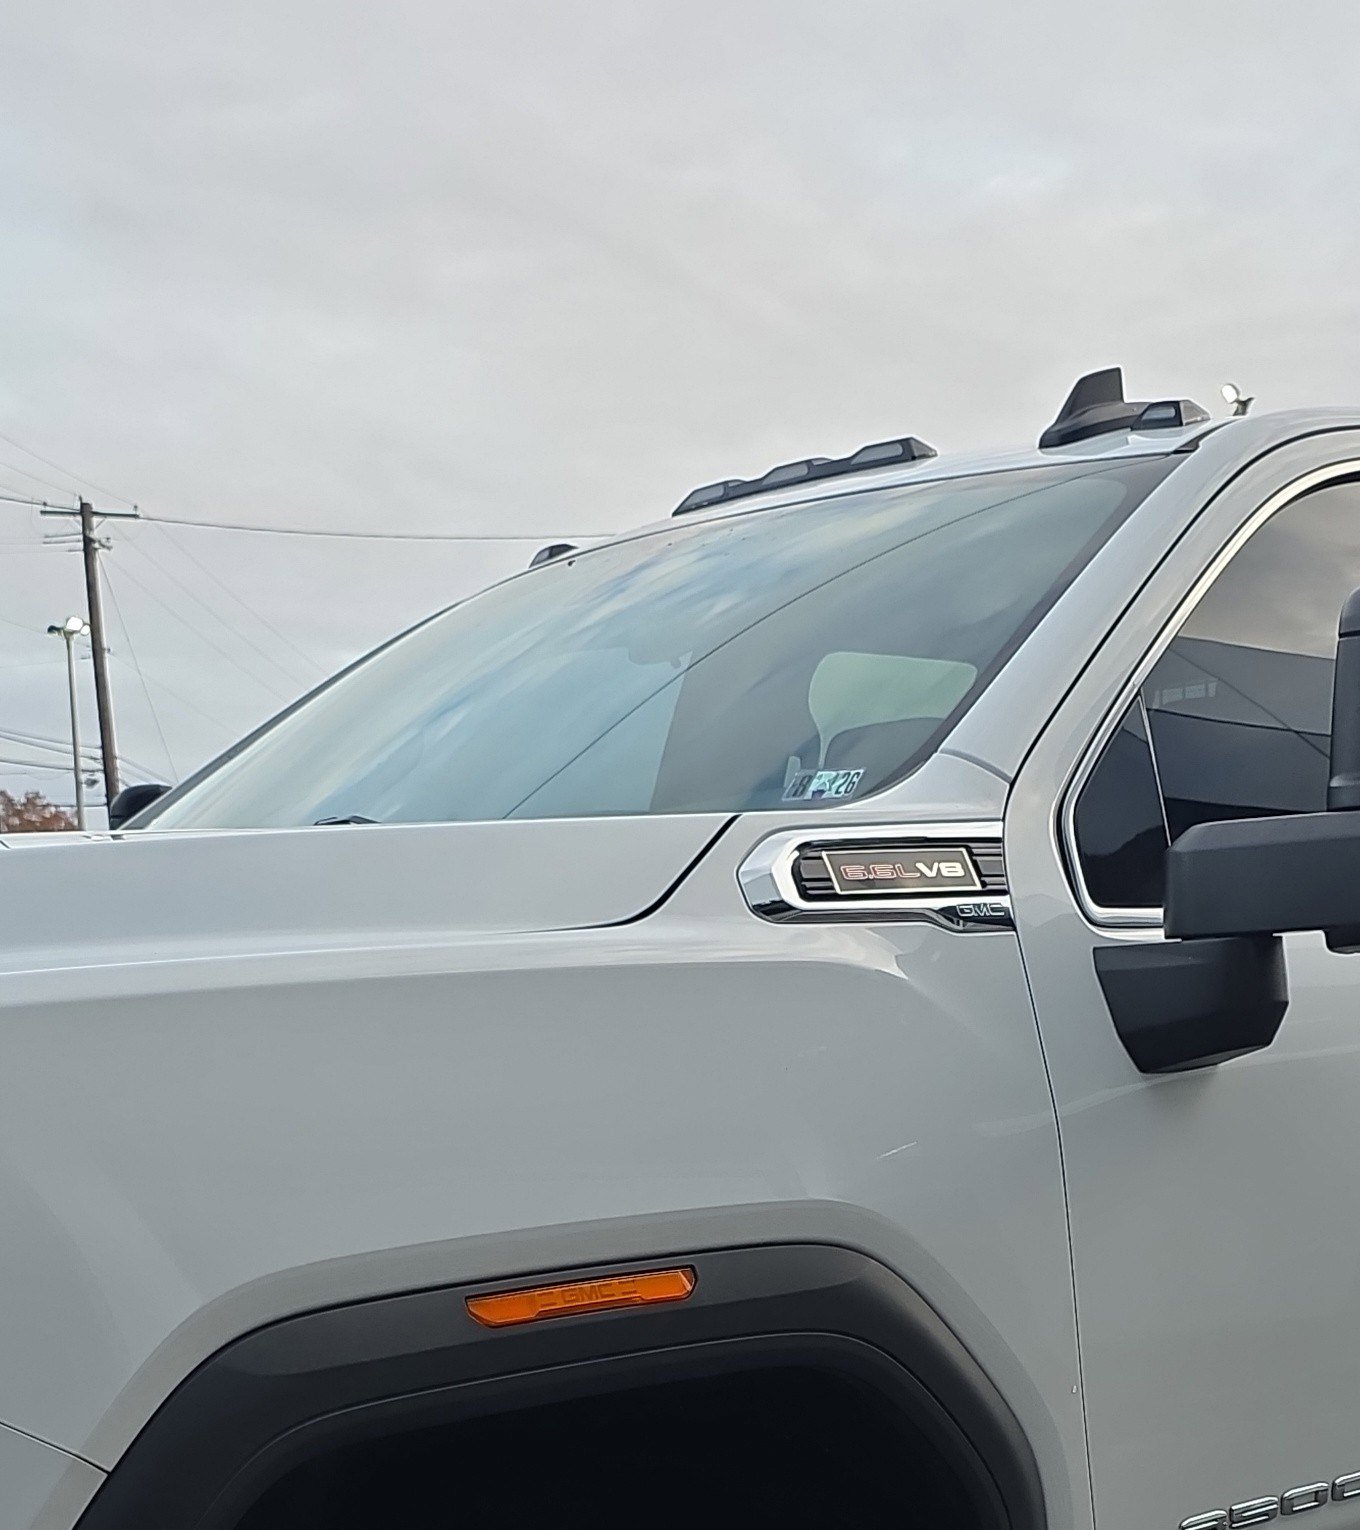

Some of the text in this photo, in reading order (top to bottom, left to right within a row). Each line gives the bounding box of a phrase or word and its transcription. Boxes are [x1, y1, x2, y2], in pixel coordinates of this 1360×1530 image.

[835, 771, 861, 795] 26
[955, 903, 1005, 917] GMC
[561, 1282, 616, 1302] GMC
